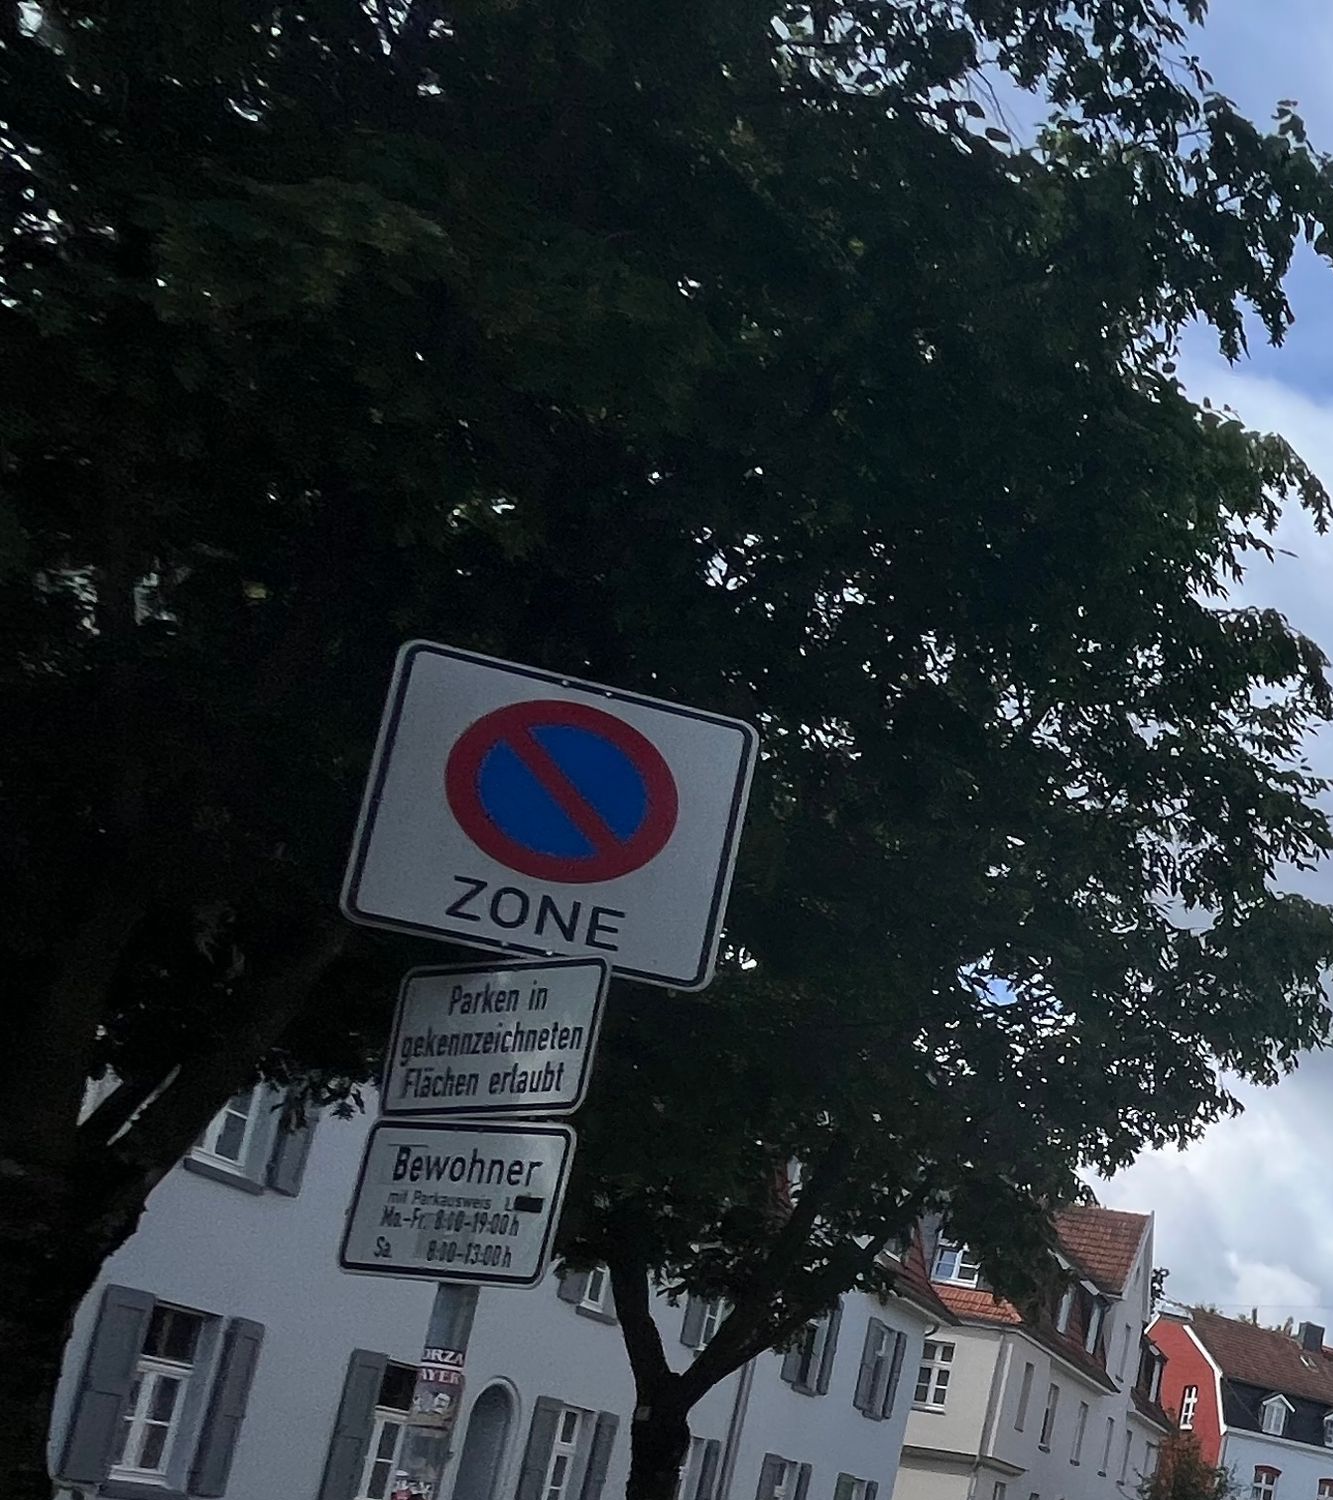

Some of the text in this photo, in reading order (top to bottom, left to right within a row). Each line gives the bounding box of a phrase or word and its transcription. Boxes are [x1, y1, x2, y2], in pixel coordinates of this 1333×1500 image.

[445, 876, 625, 951] ZONE
[449, 980, 549, 1016] Parken in
[400, 1021, 584, 1067] gekennzeichneten
[402, 1062, 565, 1099] Flächen erlaubt
[393, 1145, 544, 1187] Bewohner
[388, 1191, 409, 1205] mit
[412, 1189, 492, 1211] Parkausweis
